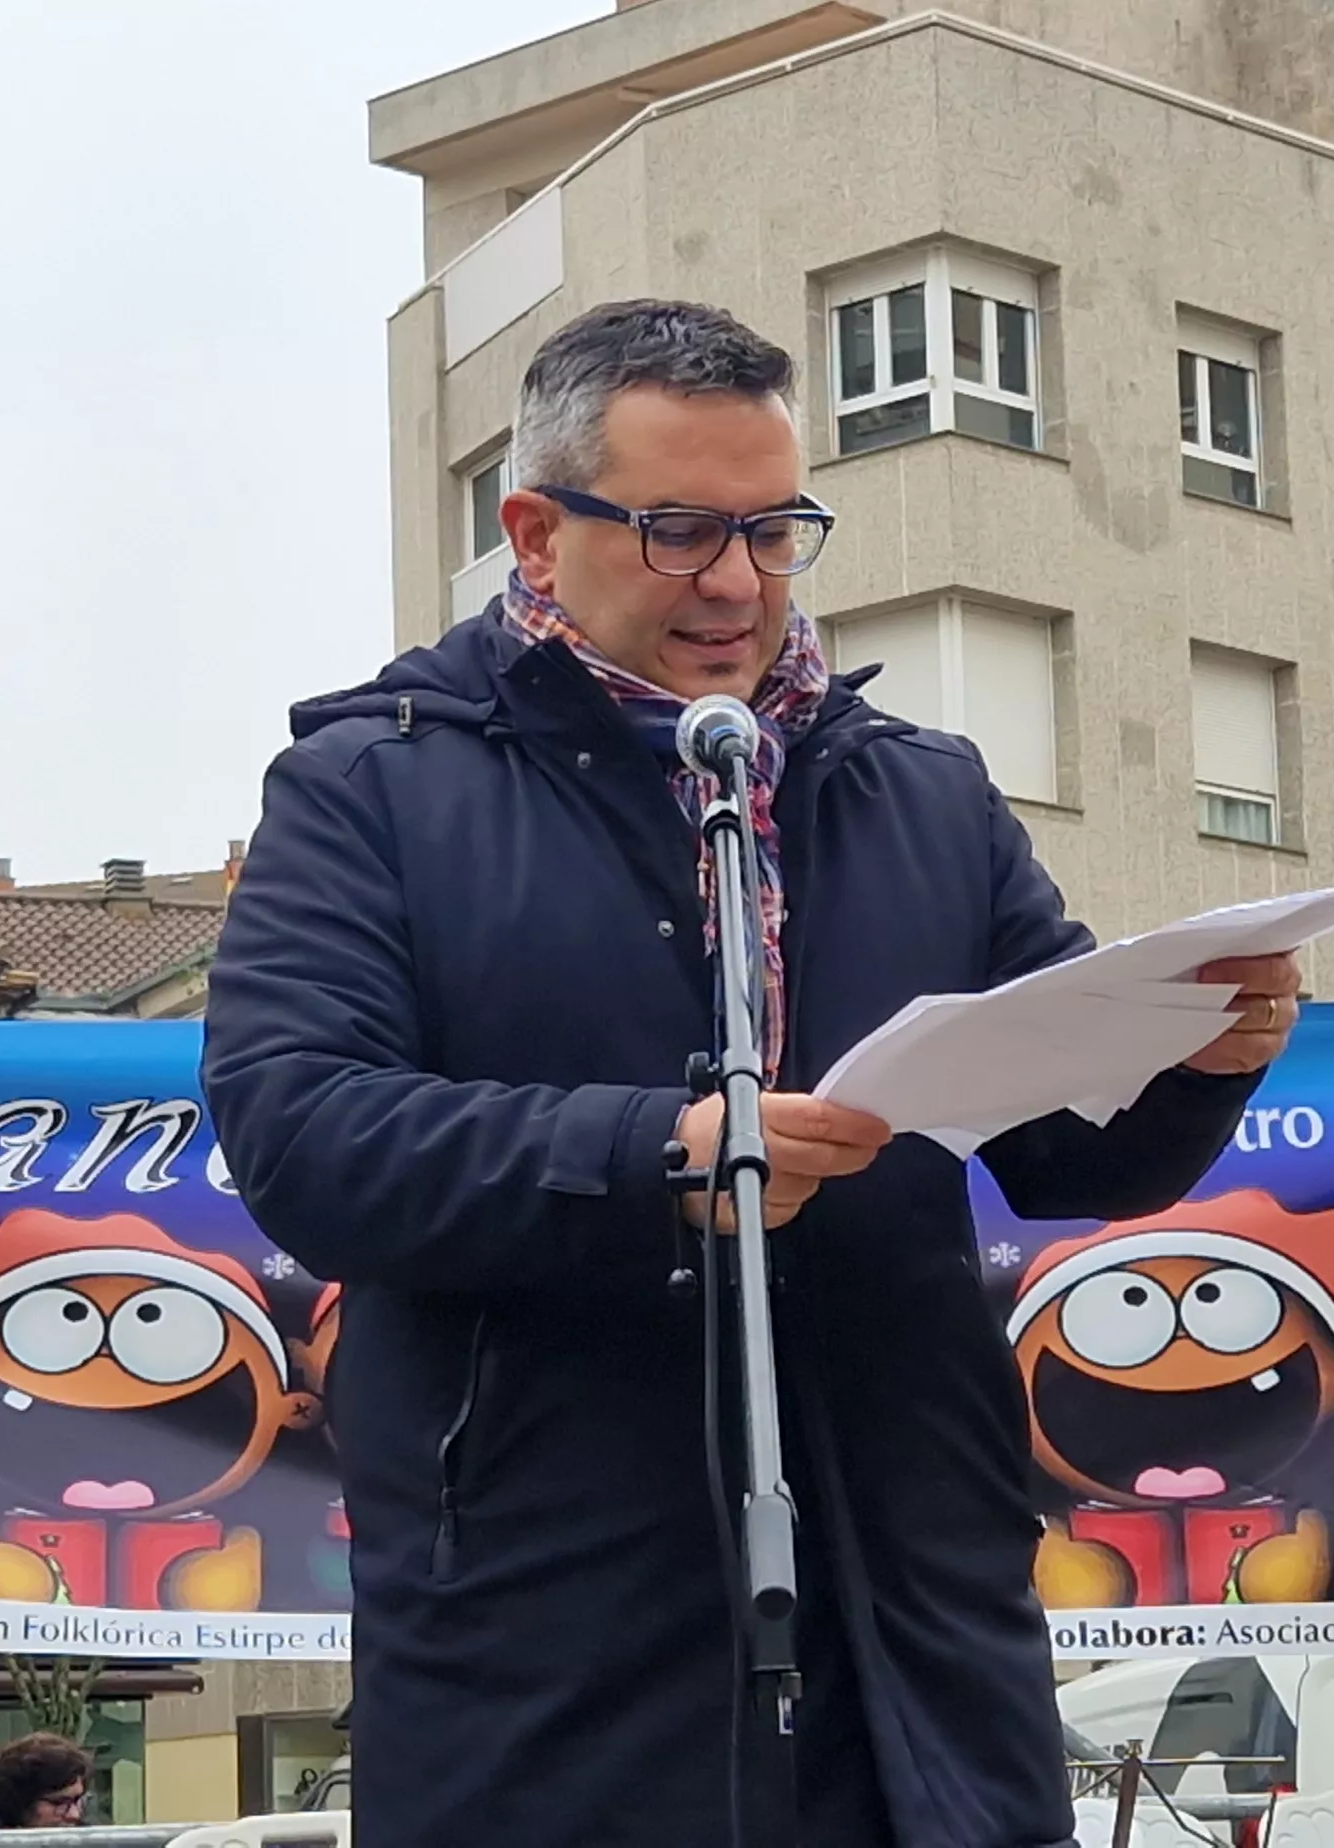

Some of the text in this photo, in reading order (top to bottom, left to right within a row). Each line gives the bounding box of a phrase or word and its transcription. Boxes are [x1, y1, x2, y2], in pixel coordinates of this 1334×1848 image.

[1235, 1106, 1324, 1152] tro
[23, 1614, 182, 1648] Folklórica
[196, 1623, 305, 1656] Estirpe
[1055, 1619, 1206, 1648] olabora:
